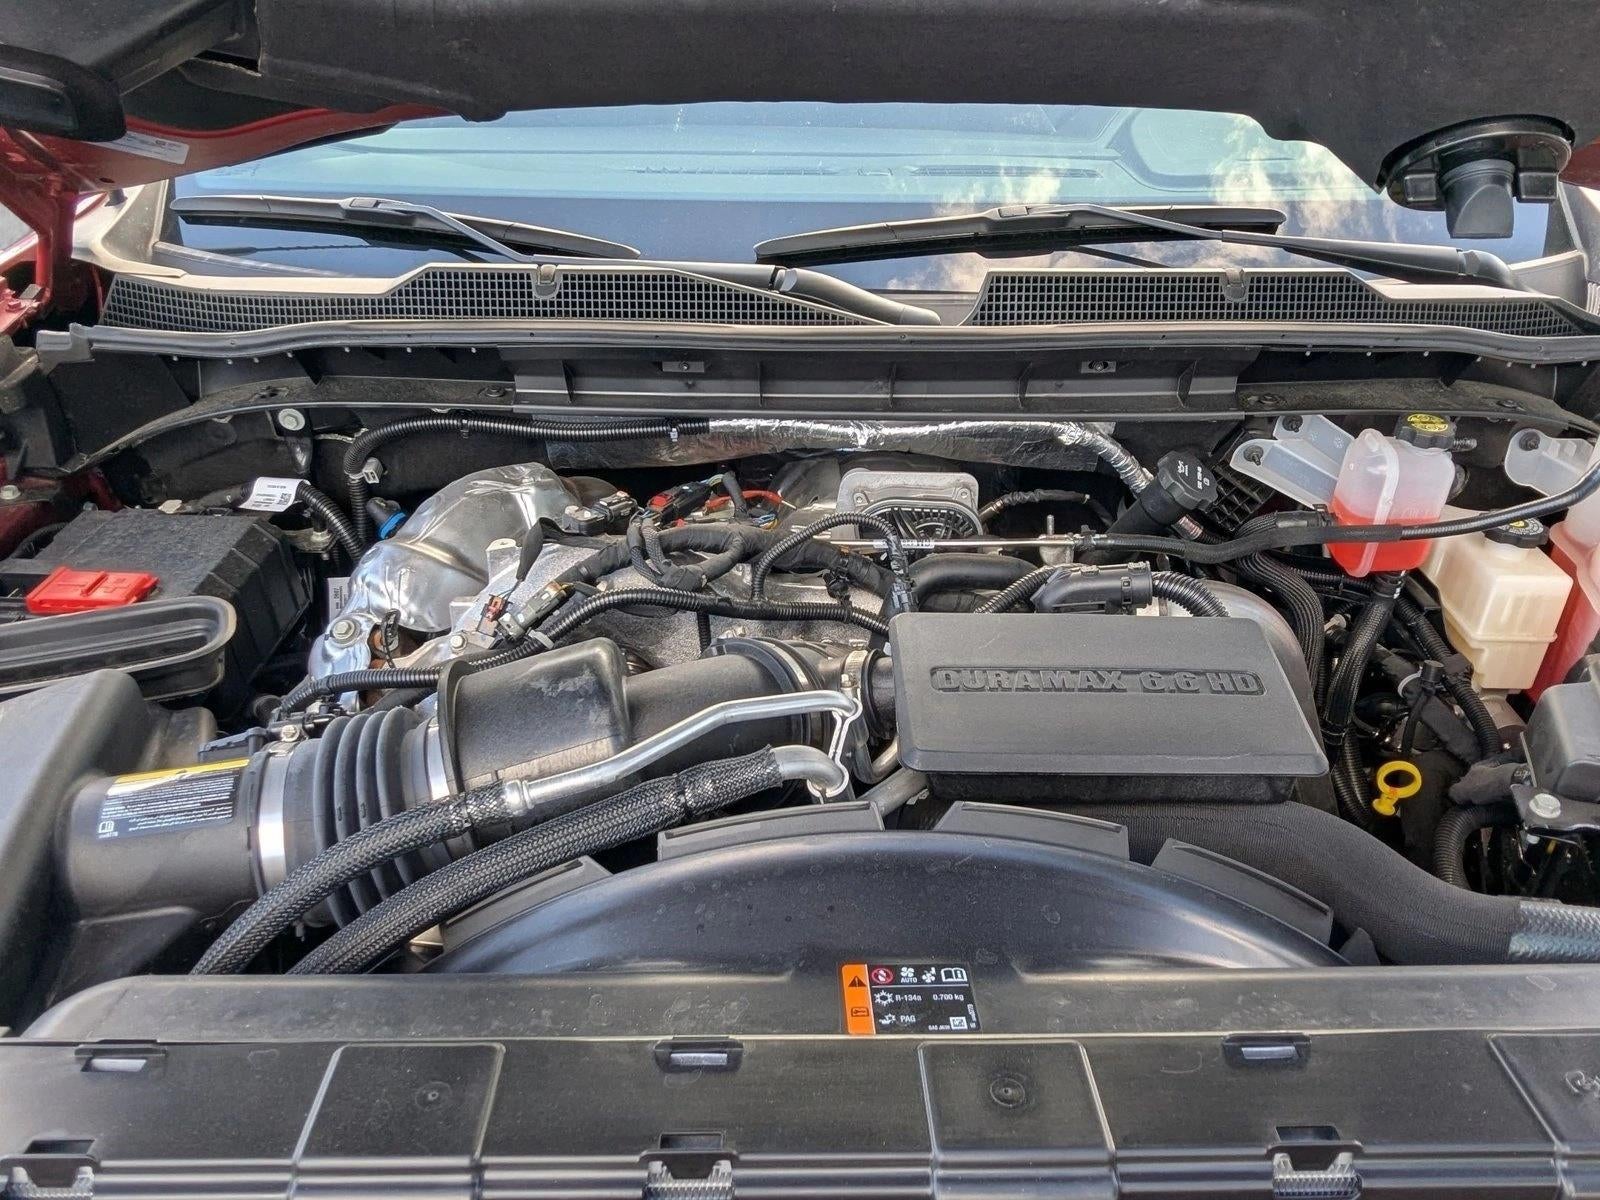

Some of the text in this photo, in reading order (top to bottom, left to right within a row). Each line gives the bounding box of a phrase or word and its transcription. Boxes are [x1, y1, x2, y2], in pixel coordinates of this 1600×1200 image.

[936, 669, 1264, 695] DURAMAX 6.6 HD
[932, 993, 964, 1002] 0.700 kg
[900, 1015, 916, 1023] PAG
